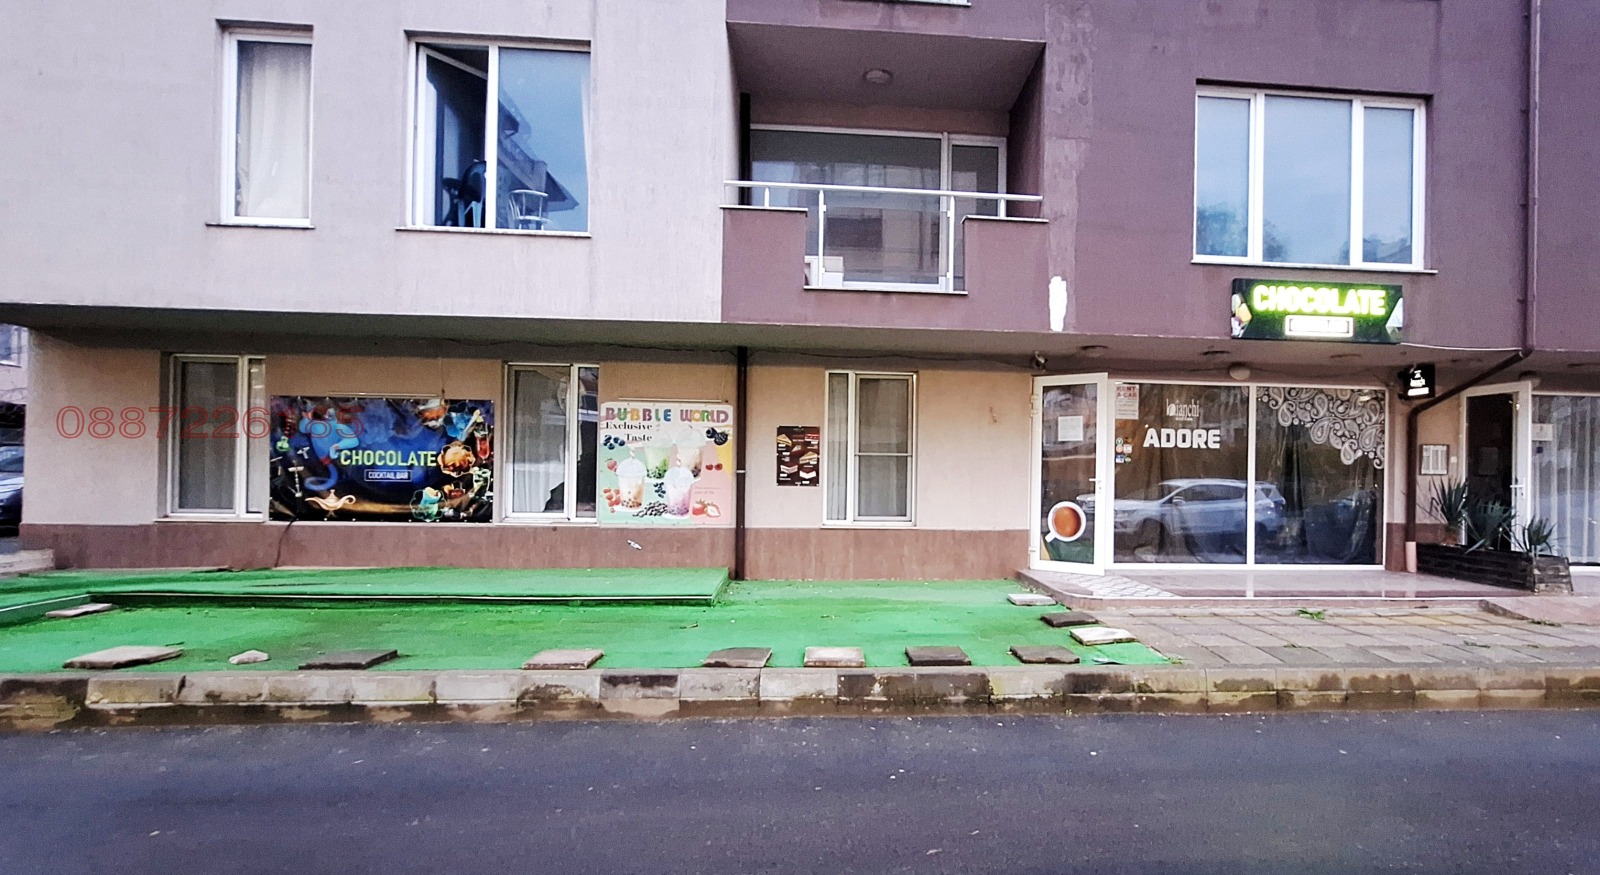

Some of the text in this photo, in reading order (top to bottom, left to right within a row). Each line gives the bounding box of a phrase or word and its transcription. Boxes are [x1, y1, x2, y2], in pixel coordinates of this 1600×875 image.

[1252, 284, 1386, 315] CHOCOLATE
[605, 407, 729, 423] BUBBLE WORLD
[605, 421, 653, 430] Exclusive
[625, 433, 653, 442] Taste
[1142, 428, 1221, 449] ADORE
[340, 450, 437, 466] CHOCOLATE
[368, 471, 409, 480] COCKTAIL BAR
